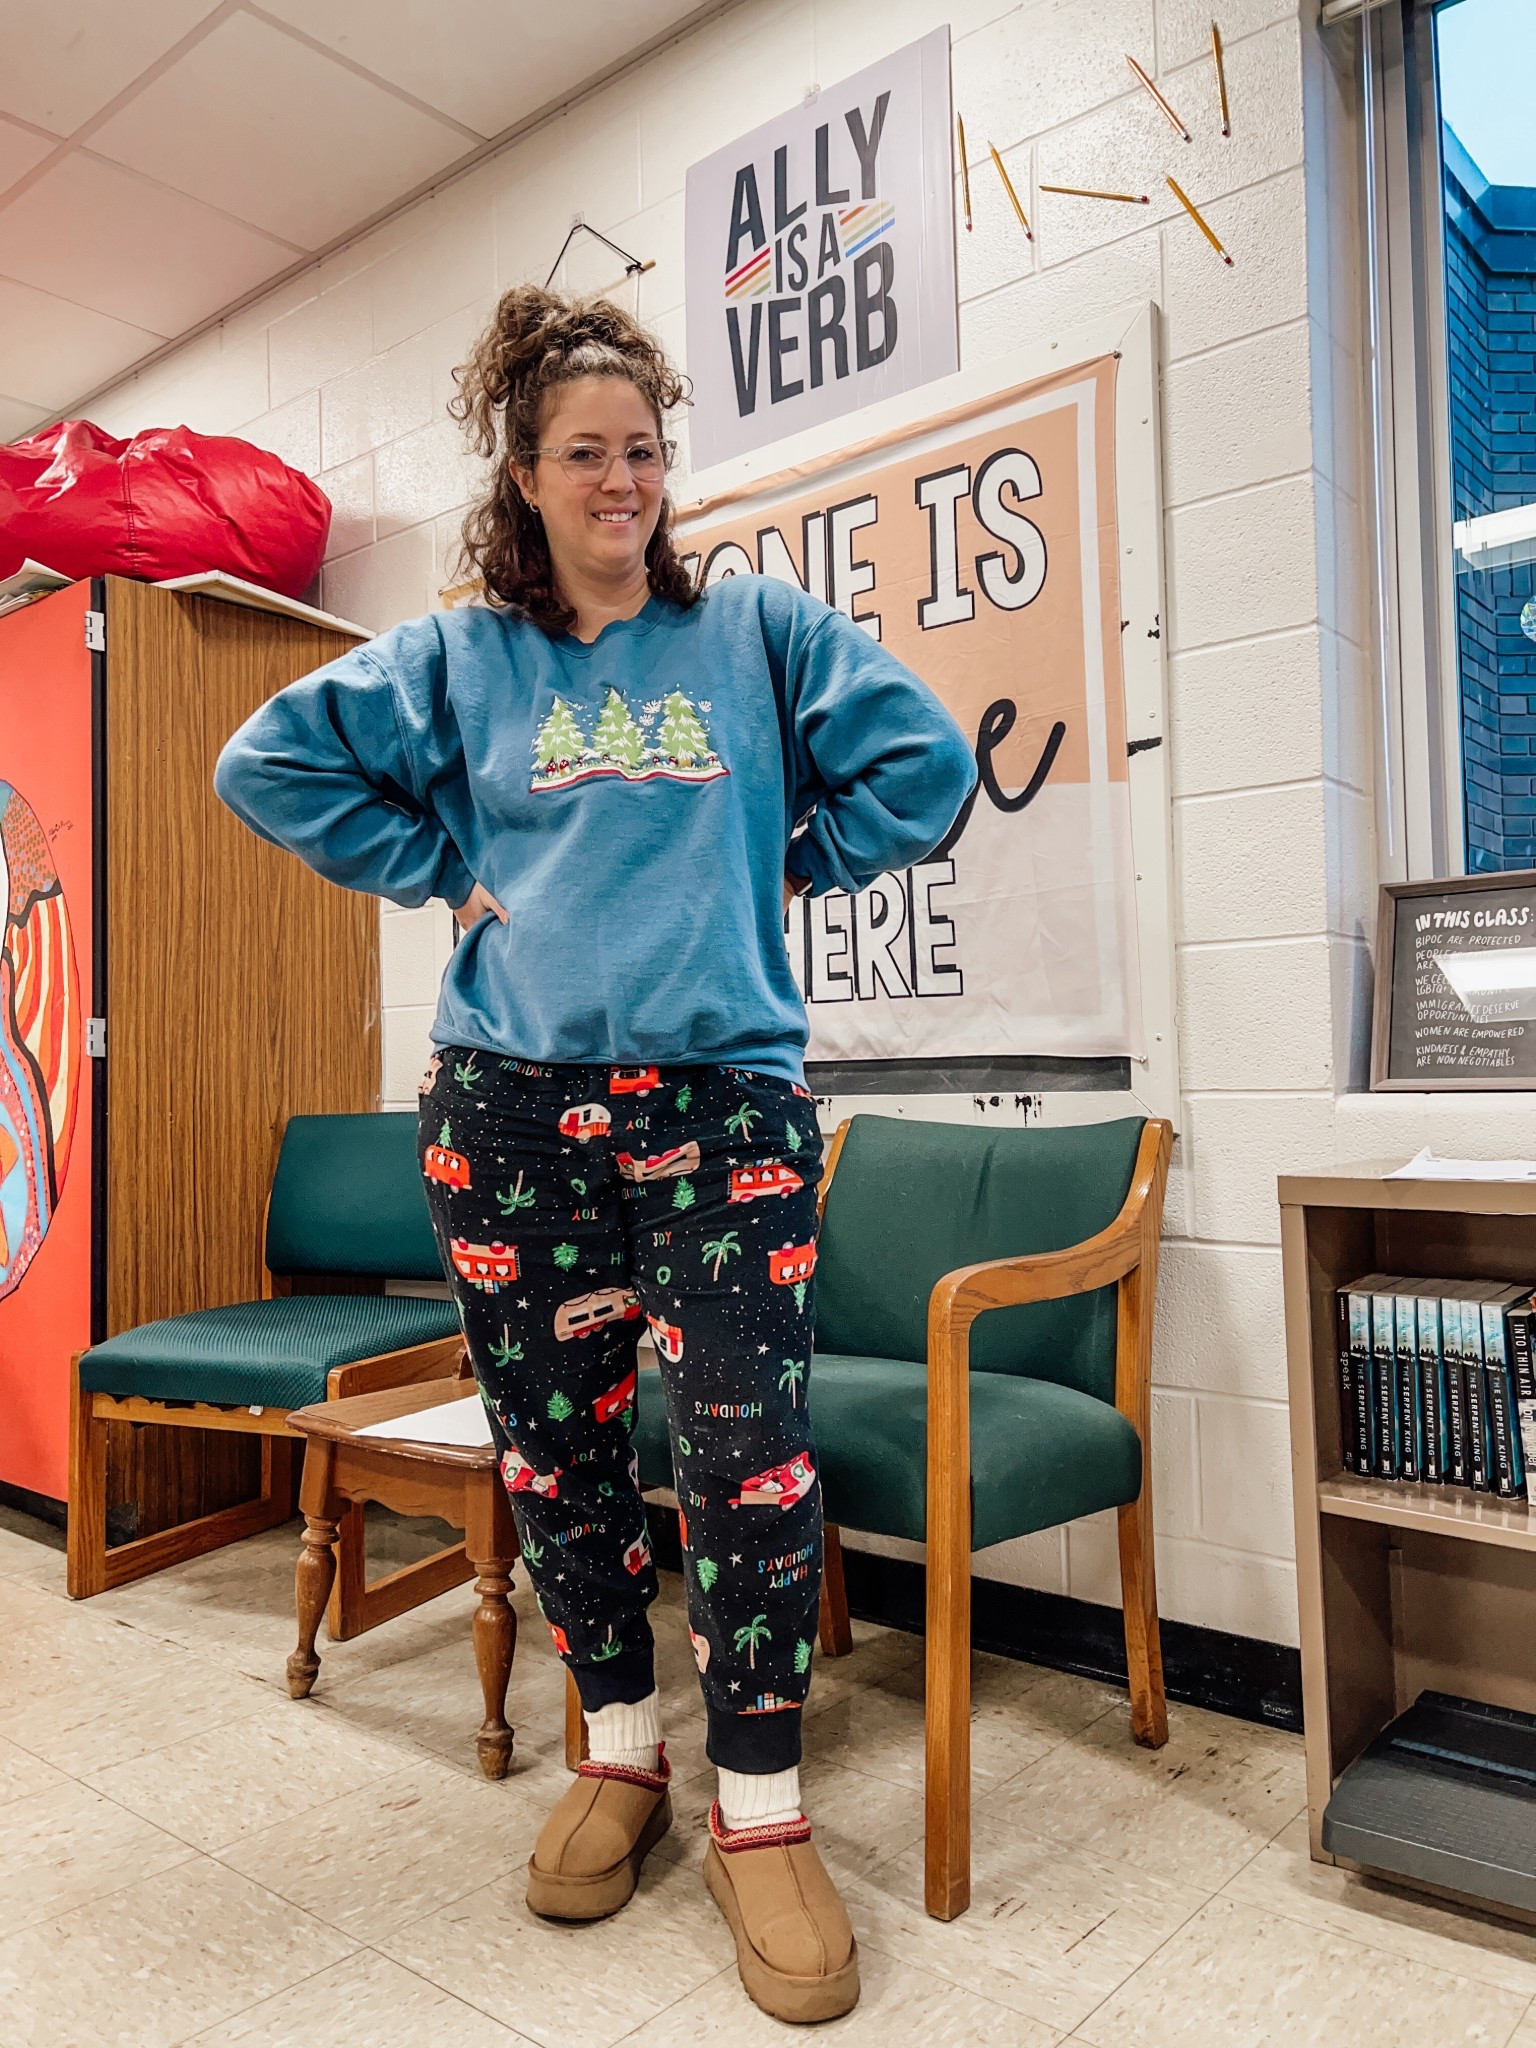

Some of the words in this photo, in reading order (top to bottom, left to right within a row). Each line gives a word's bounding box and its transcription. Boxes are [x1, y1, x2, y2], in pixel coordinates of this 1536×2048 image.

[725, 90, 892, 274] ALLY
[775, 222, 808, 294] IS
[817, 212, 842, 281] A
[725, 241, 899, 418] VERB
[915, 447, 1048, 632] IS
[1415, 913, 1431, 932] IN
[1433, 911, 1471, 929] THIS
[1473, 907, 1534, 928] CLASS:
[1415, 934, 1443, 949] BIPOC
[1447, 935, 1465, 945] ARE
[1468, 935, 1521, 946] PROTECTED
[1416, 960, 1434, 971] ARE
[1415, 974, 1430, 986] WE
[1416, 999, 1481, 1015] IMMIGRANTS
[1482, 1000, 1520, 1015] DESERVE
[1417, 1009, 1489, 1024] OPPORTUNITIES
[1415, 1025, 1452, 1039] WOMEN
[1452, 1027, 1470, 1038] ARE
[1471, 1026, 1525, 1039] EMPOWERED
[1416, 1043, 1459, 1056] KINDNESS
[1460, 1045, 1467, 1056] &
[1469, 1046, 1511, 1059] EMPATHY
[1416, 1055, 1431, 1068] ARE
[1436, 1055, 1456, 1065] NON
[1457, 1055, 1516, 1068] NEGOTIABLES
[498, 1059, 553, 1078] HOLIDAYS
[625, 1116, 651, 1131] JOY
[571, 1206, 599, 1221] JOY
[652, 1231, 672, 1247] JOY
[1489, 1325, 1498, 1352] ZENNER
[1513, 1323, 1527, 1347] INTO
[1341, 1351, 1351, 1390] speak
[1516, 1351, 1530, 1374] THIN
[1493, 1376, 1501, 1394] THE
[1519, 1378, 1532, 1396] AIR
[694, 1401, 763, 1419] HOLIDAYS
[1358, 1384, 1366, 1424] SERPENT
[1381, 1385, 1389, 1425] SERPENT
[1403, 1386, 1411, 1427] SERPENT
[1426, 1389, 1434, 1429] SERPENT
[1451, 1389, 1460, 1430] SERPENT
[1470, 1393, 1479, 1435] SERPENT
[1494, 1399, 1505, 1441] SERPENT
[1404, 1430, 1412, 1453] KING
[1453, 1433, 1461, 1457] KING
[1473, 1438, 1481, 1462] KING
[570, 1448, 596, 1467] JOY
[1498, 1445, 1507, 1469] KING
[689, 1490, 707, 1510] JOY
[550, 1523, 606, 1546] HOLIDAYS
[757, 1543, 814, 1574] HOLIDAYS
[769, 1563, 808, 1589] HAPPY
